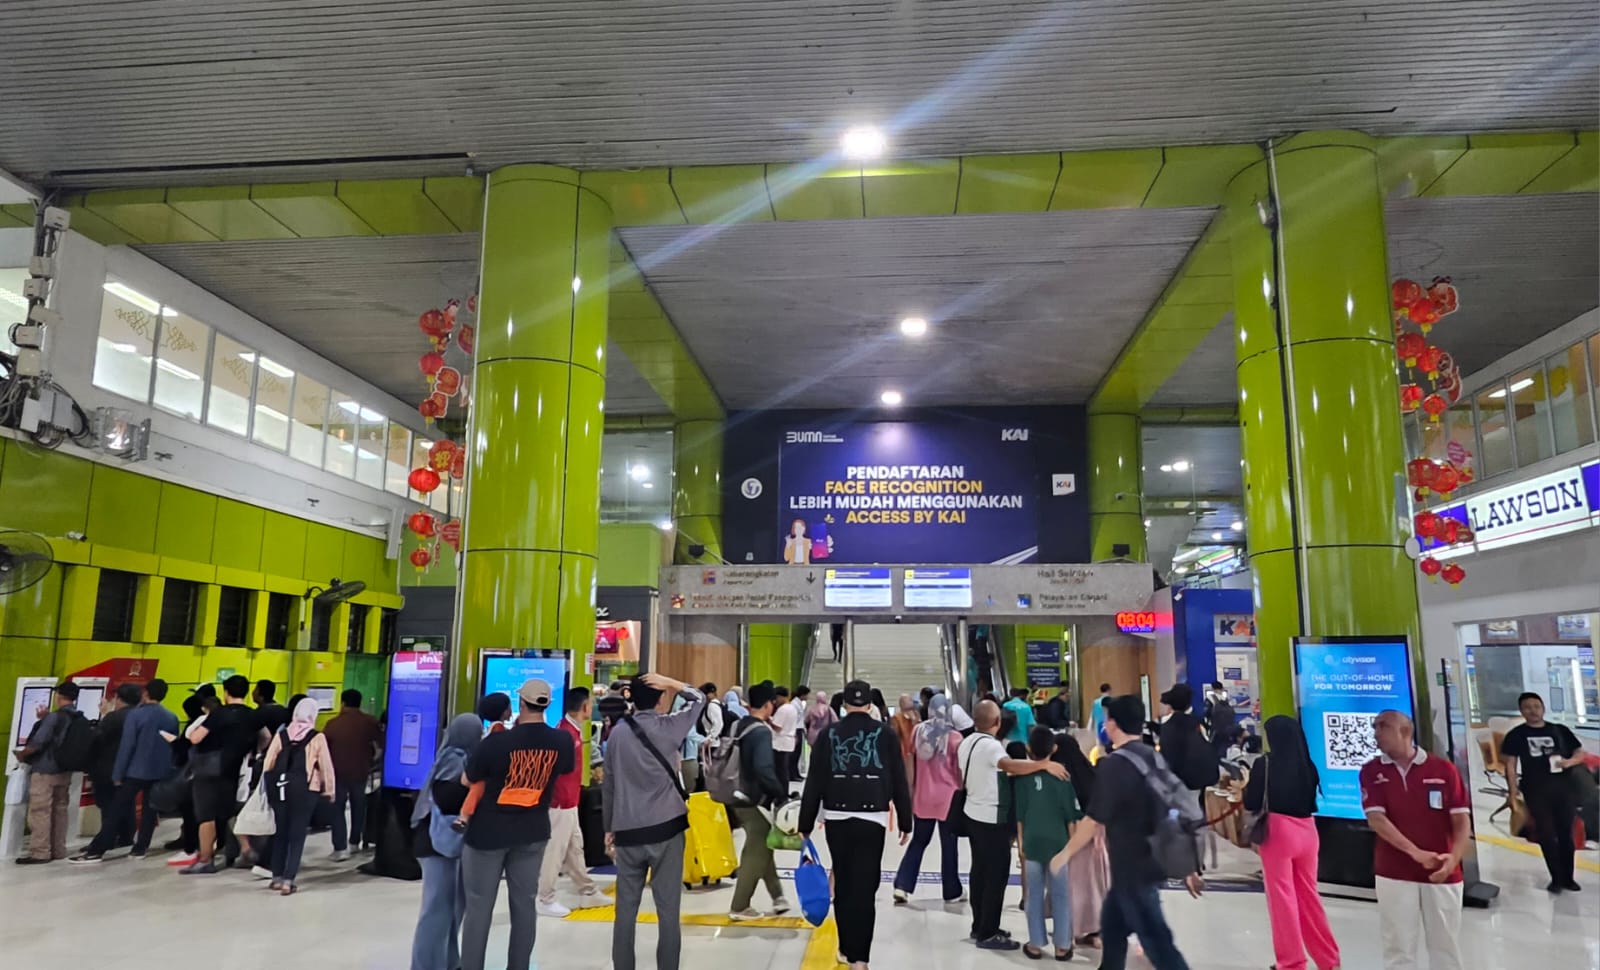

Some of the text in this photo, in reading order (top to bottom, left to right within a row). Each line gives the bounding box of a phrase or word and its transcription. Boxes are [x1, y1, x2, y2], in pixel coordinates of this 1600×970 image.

[1001, 429, 1029, 441] KAI
[847, 466, 964, 479] PENDAFTARAN
[825, 480, 983, 494] FACE RECOGNITION
[1056, 481, 1072, 489] KAI
[790, 495, 1023, 509] LEBIH MUDAH MENGGUNAKAN
[1471, 478, 1583, 532] LAWSON
[845, 510, 966, 524] ACCESS BY KAI
[1220, 619, 1256, 636] KAI
[1311, 674, 1395, 682] THE OUT-OF-HOME
[1336, 683, 1393, 692] TOMORROW
